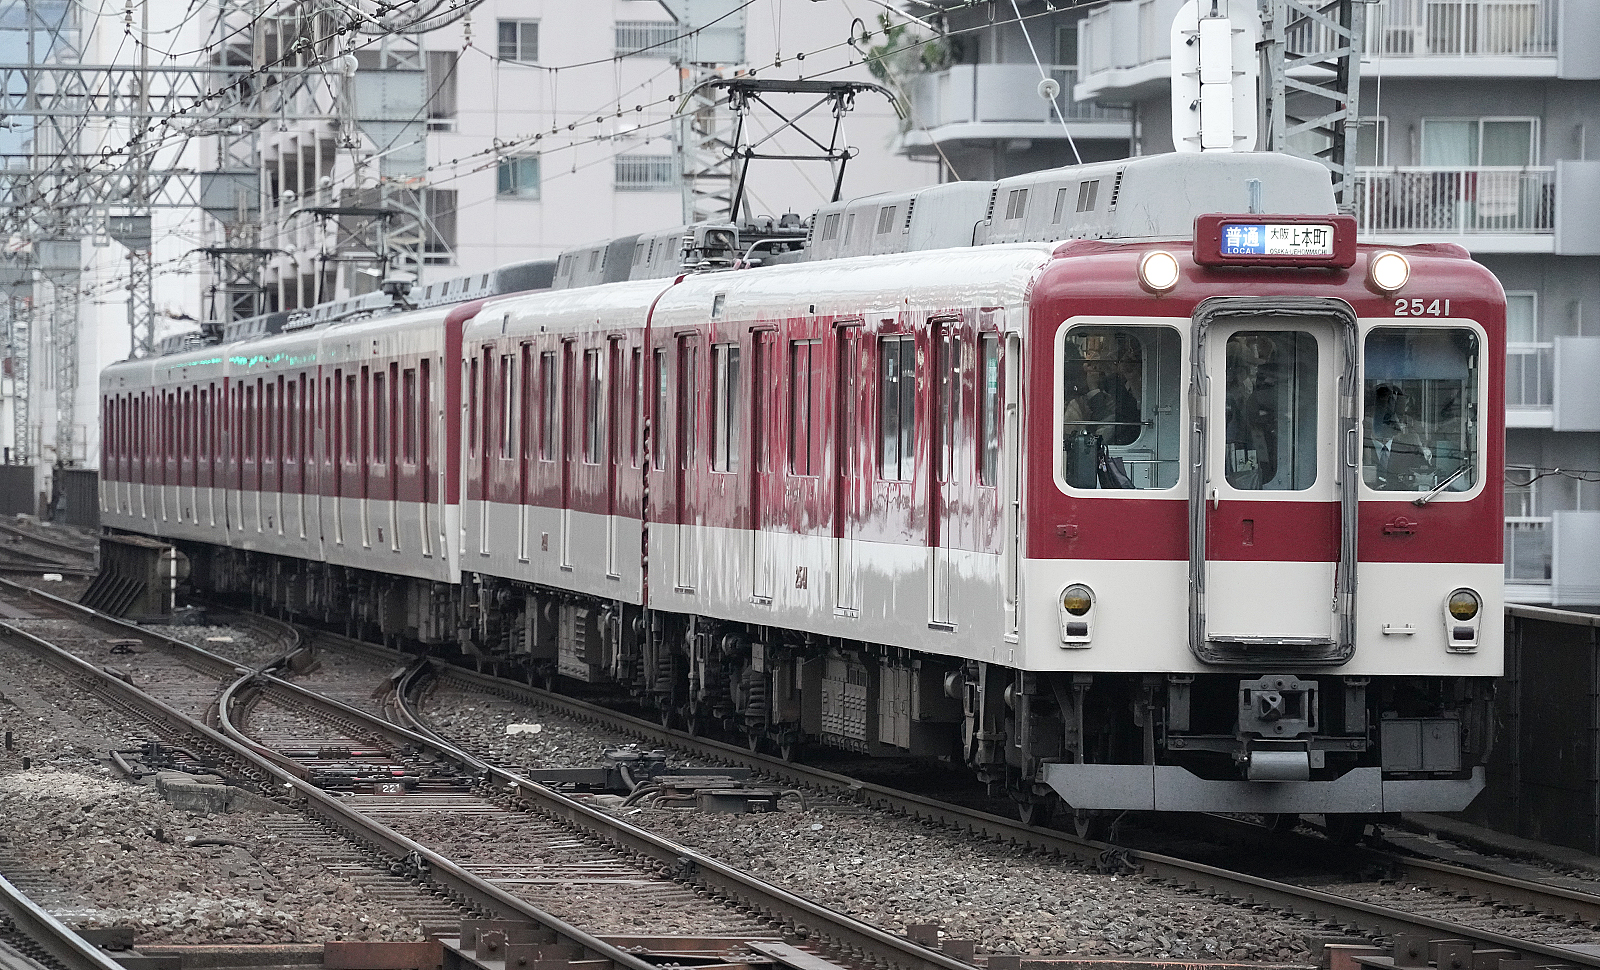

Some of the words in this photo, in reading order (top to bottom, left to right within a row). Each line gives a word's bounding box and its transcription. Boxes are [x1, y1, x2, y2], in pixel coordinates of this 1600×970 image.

[1226, 227, 1259, 247] 普通
[1271, 228, 1327, 247] 大阪上本町
[1395, 298, 1450, 316] 2541
